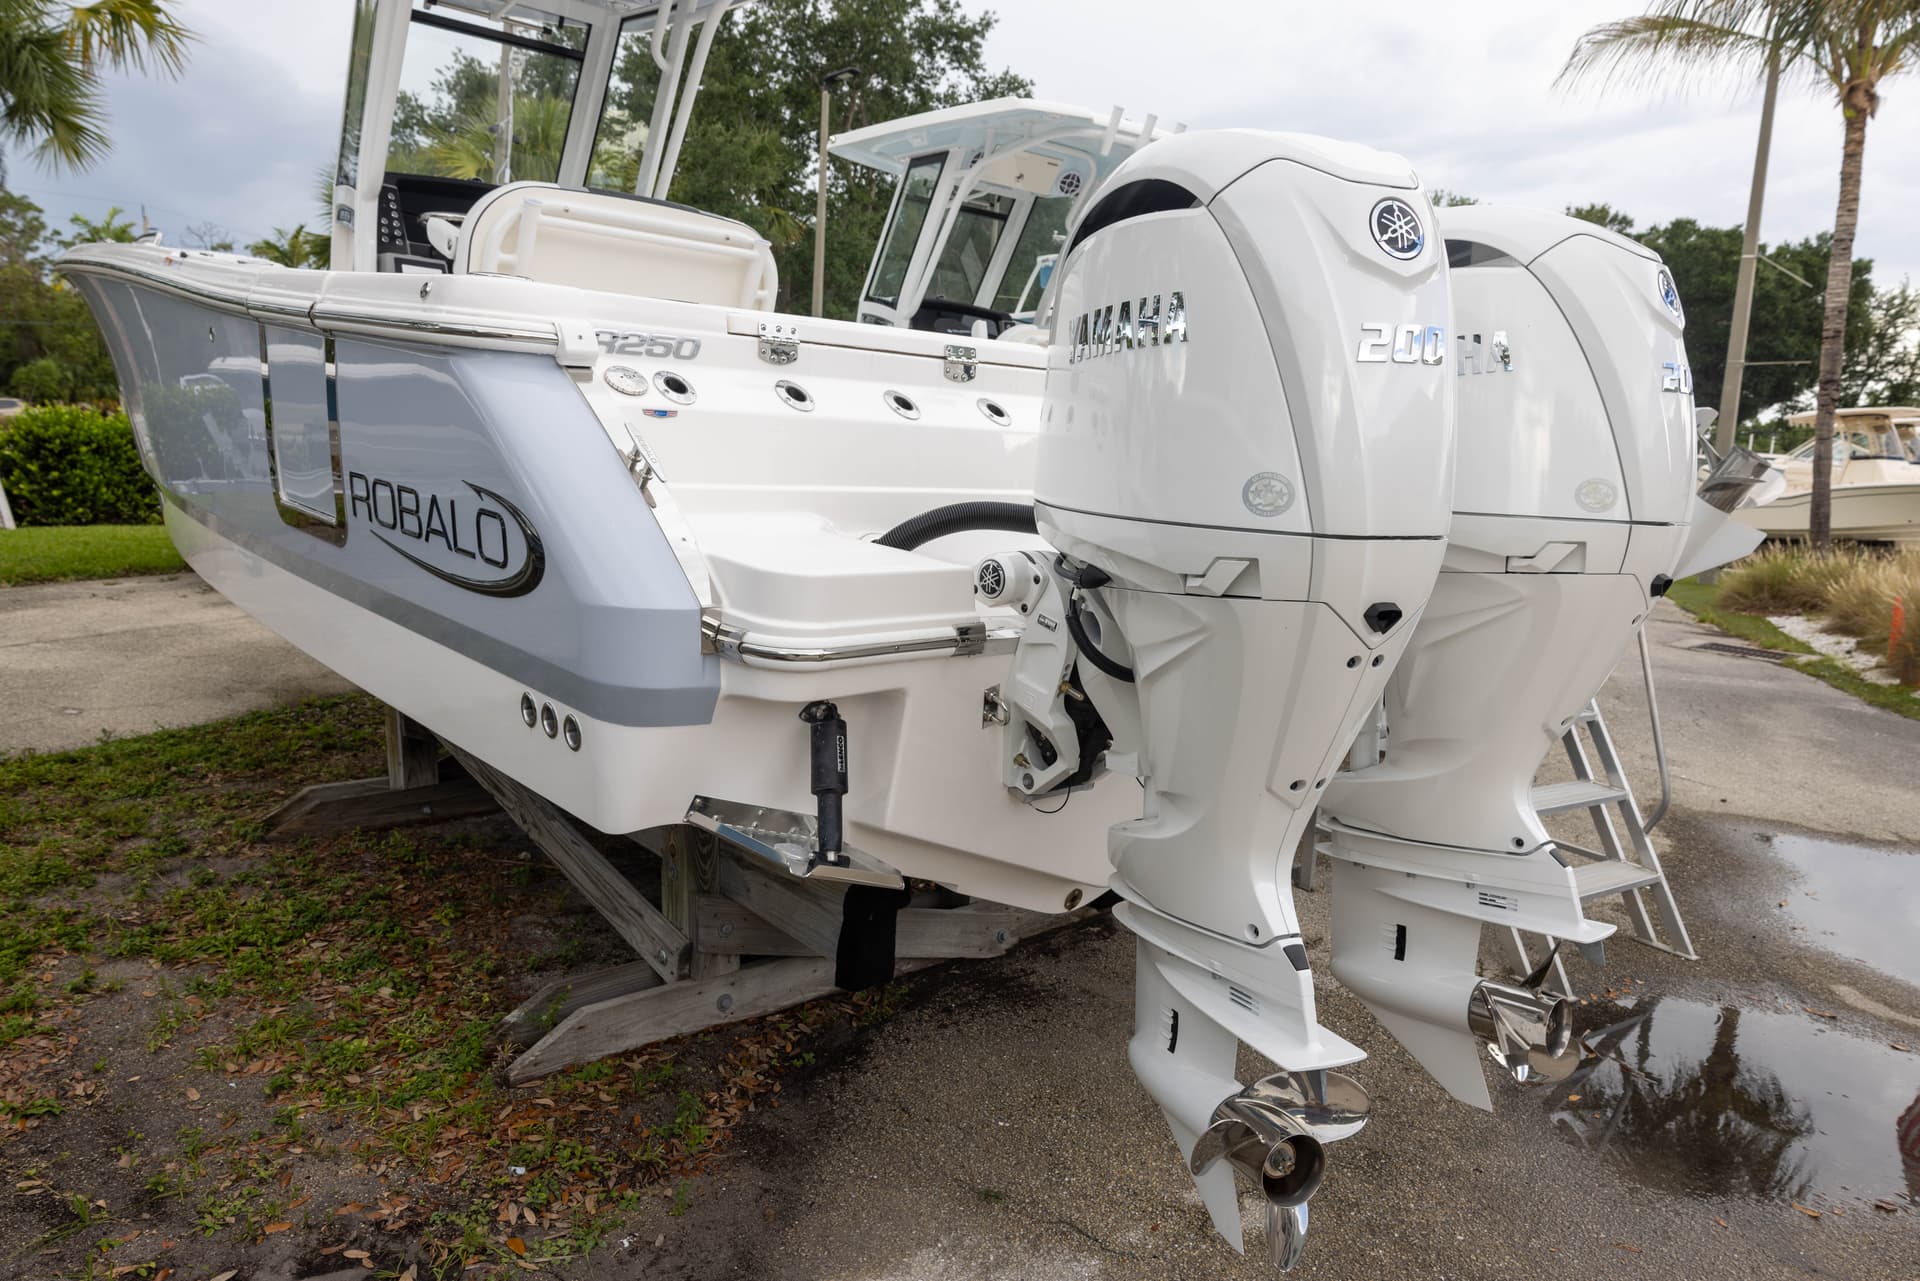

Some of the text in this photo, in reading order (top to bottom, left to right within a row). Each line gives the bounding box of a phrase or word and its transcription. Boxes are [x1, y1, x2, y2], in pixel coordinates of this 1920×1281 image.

[595, 330, 701, 361] R250
[1069, 291, 1188, 364] YAMAHA
[1356, 322, 1445, 366] 200
[1661, 361, 1693, 395] 20
[349, 471, 509, 569] ROBALO
